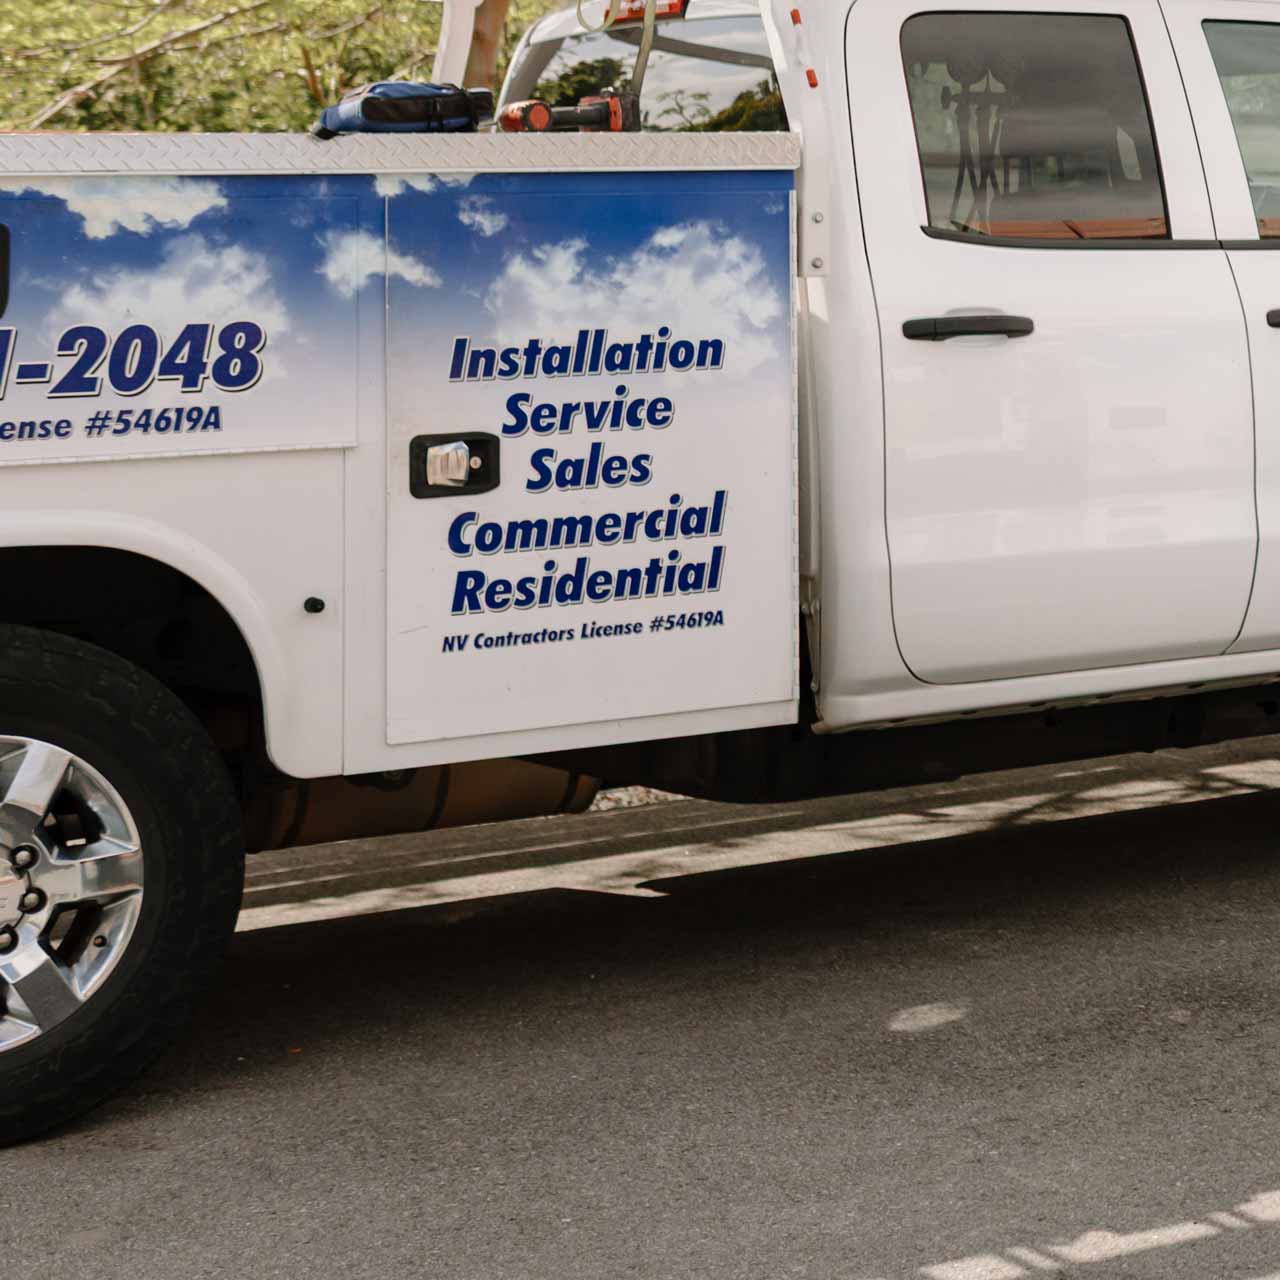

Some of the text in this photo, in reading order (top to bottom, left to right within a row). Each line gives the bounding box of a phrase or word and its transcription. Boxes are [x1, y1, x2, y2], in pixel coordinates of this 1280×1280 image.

[449, 326, 725, 381] Installation
[0, 406, 223, 440] ense #54619A
[501, 384, 674, 437] Service
[526, 442, 653, 493] Sales
[447, 490, 728, 556] Commercial
[450, 545, 726, 616] Residential
[442, 609, 725, 653] NV Contractors License #54619A
